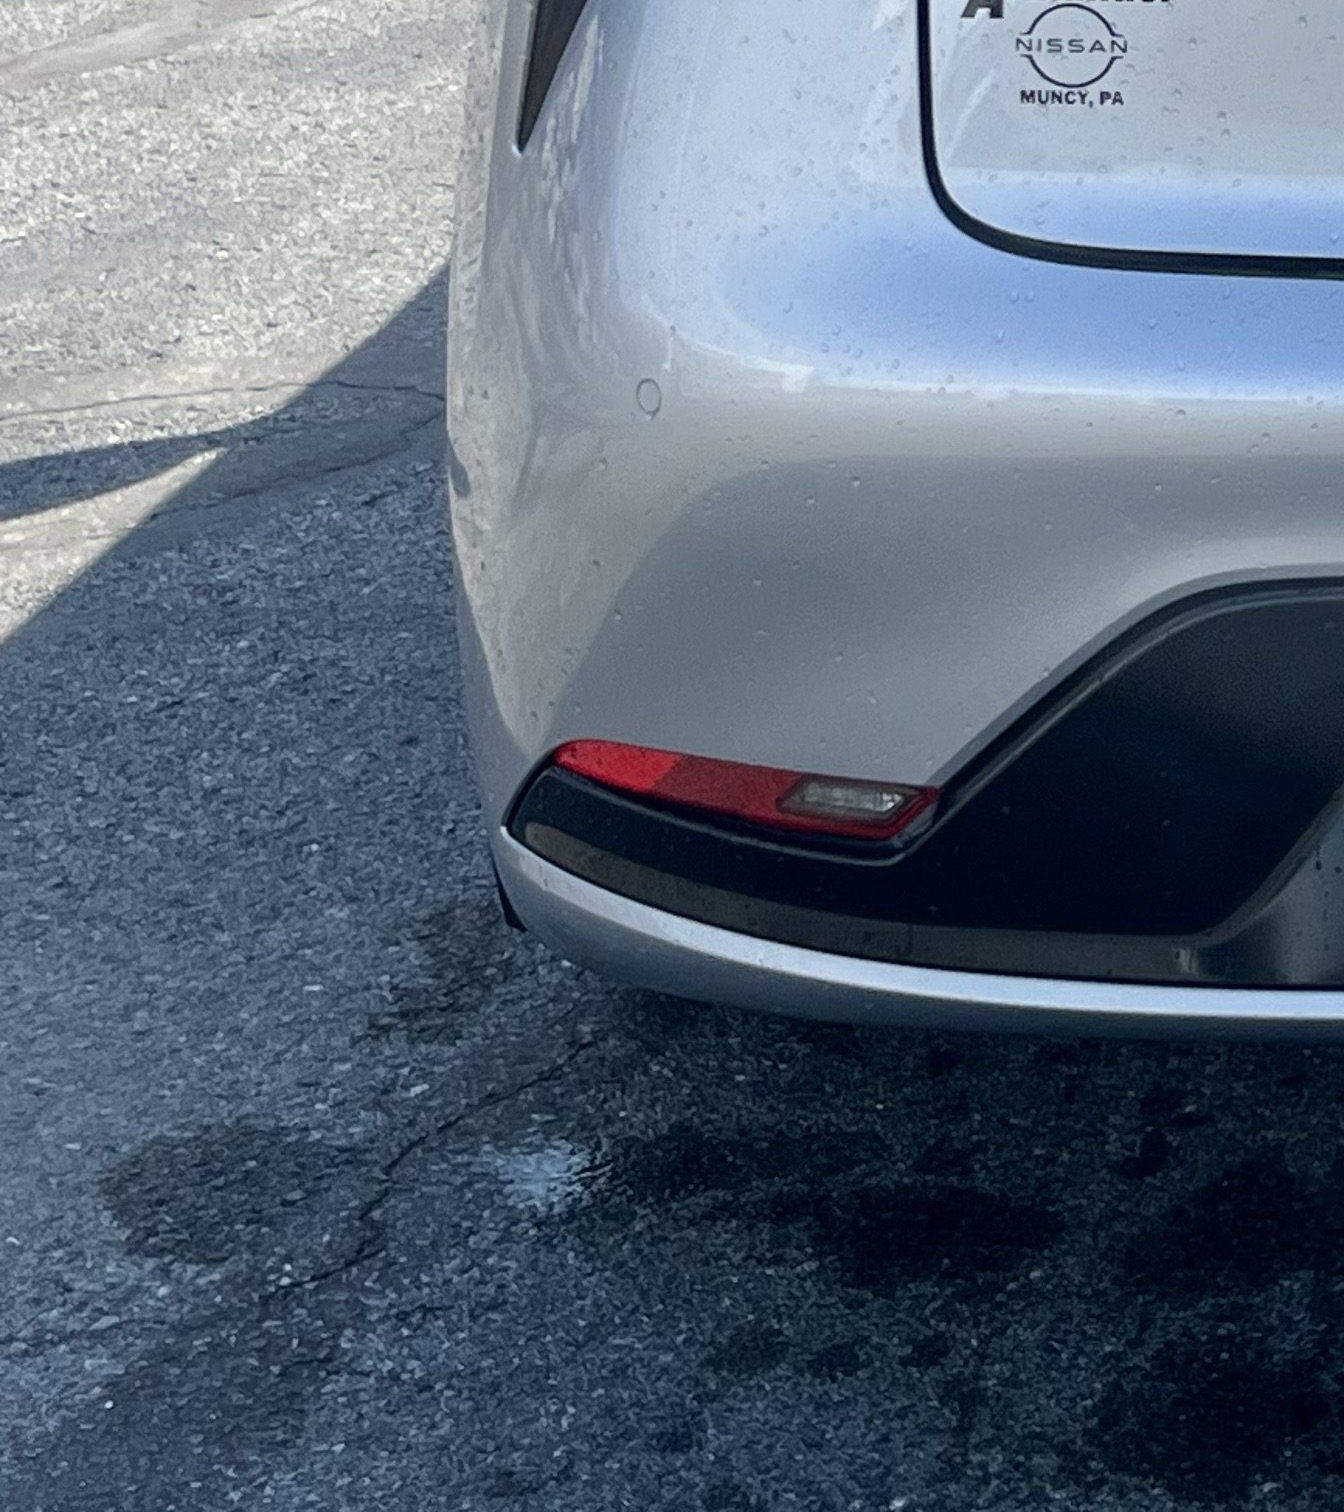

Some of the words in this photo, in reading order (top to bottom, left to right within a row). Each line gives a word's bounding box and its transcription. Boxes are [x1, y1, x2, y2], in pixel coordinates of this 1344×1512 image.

[1016, 38, 1128, 54] NISSAN
[1020, 90, 1094, 108] MUNCY,
[1099, 91, 1124, 106] PA
